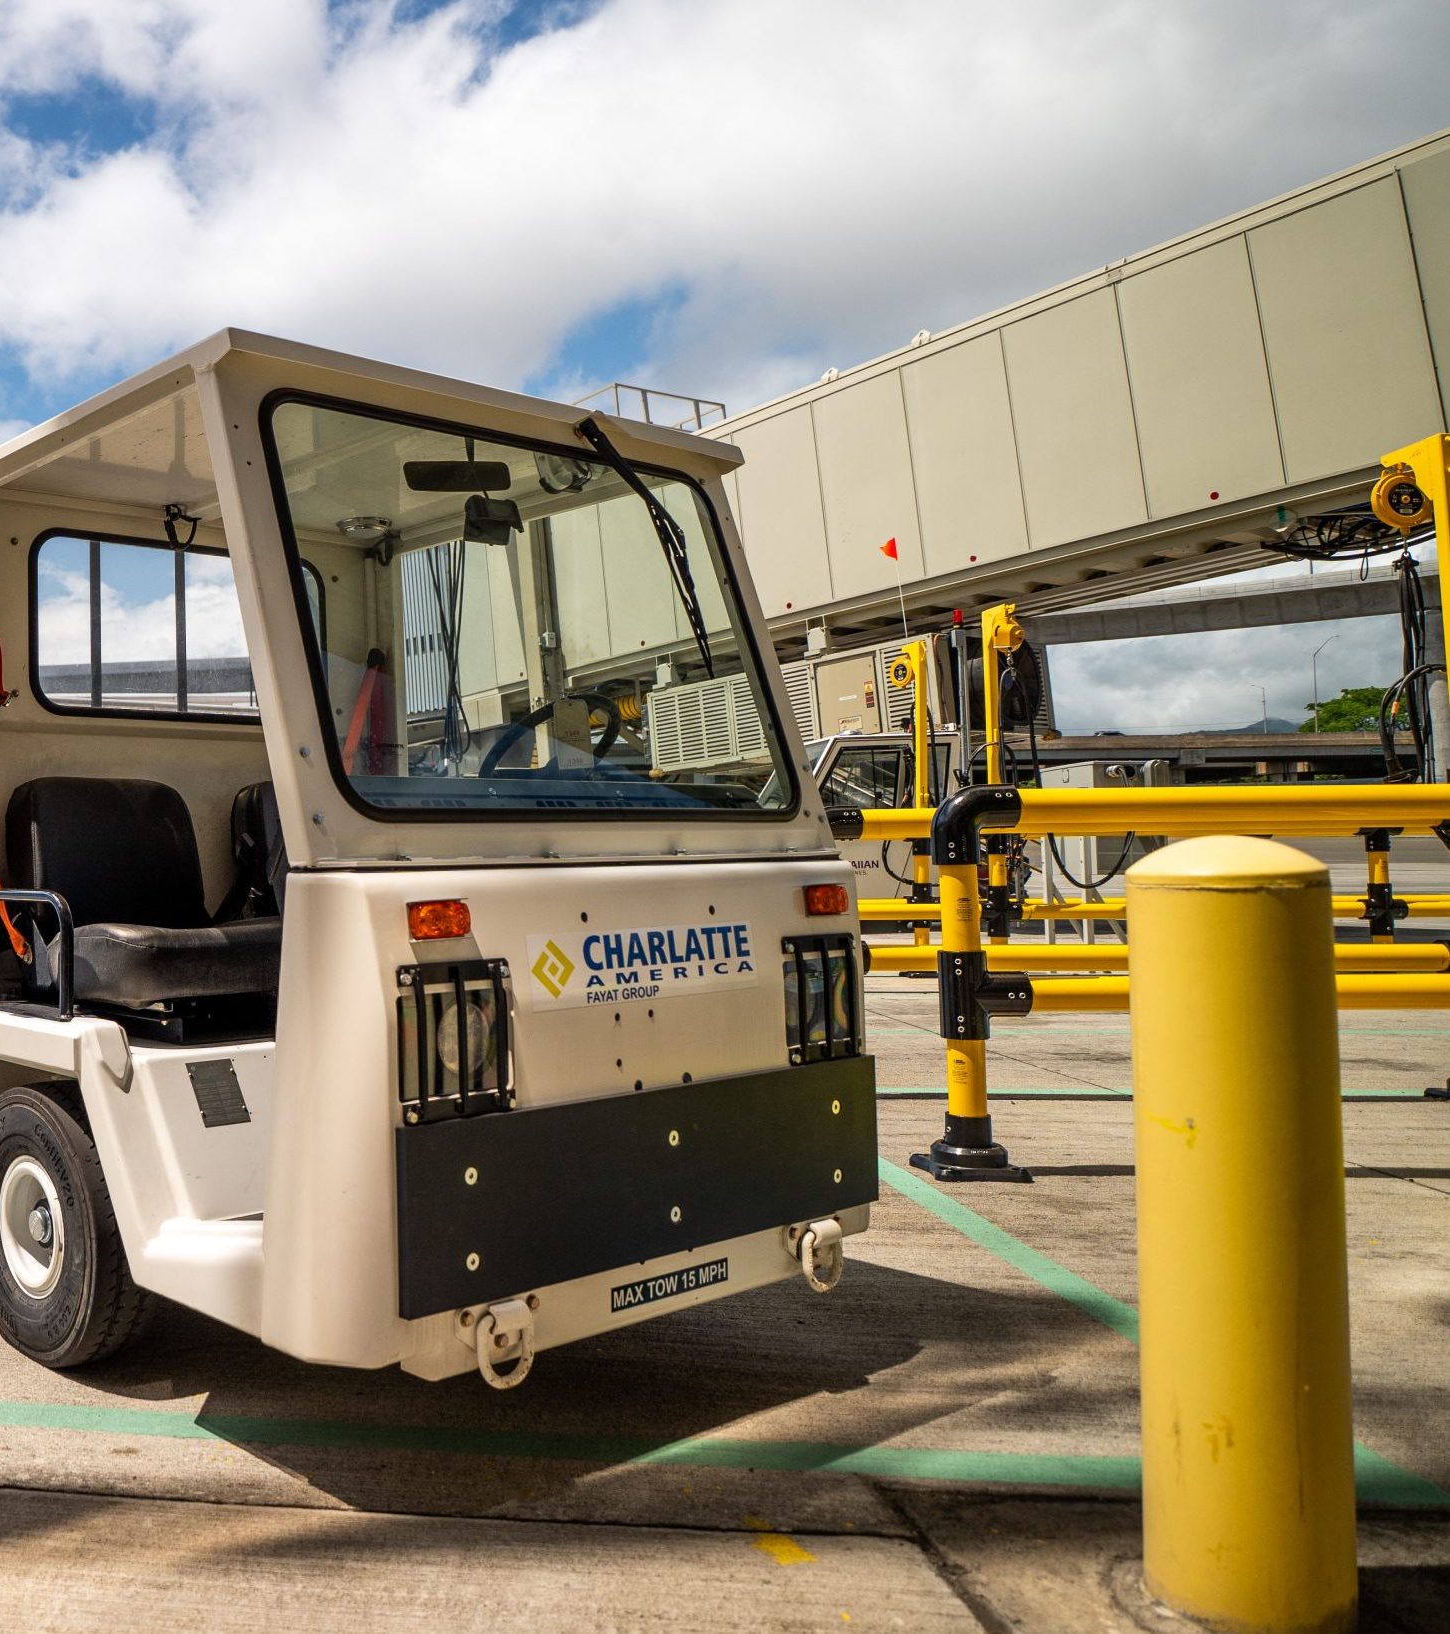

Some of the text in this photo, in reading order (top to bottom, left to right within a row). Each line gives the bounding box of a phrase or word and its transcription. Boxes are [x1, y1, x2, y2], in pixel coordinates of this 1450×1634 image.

[582, 924, 751, 971] CHARLATTE
[586, 960, 754, 988] AMERICA
[586, 985, 660, 1004] FAYAT GROUP
[613, 1261, 727, 1309] MAX TOW 15 MPH
